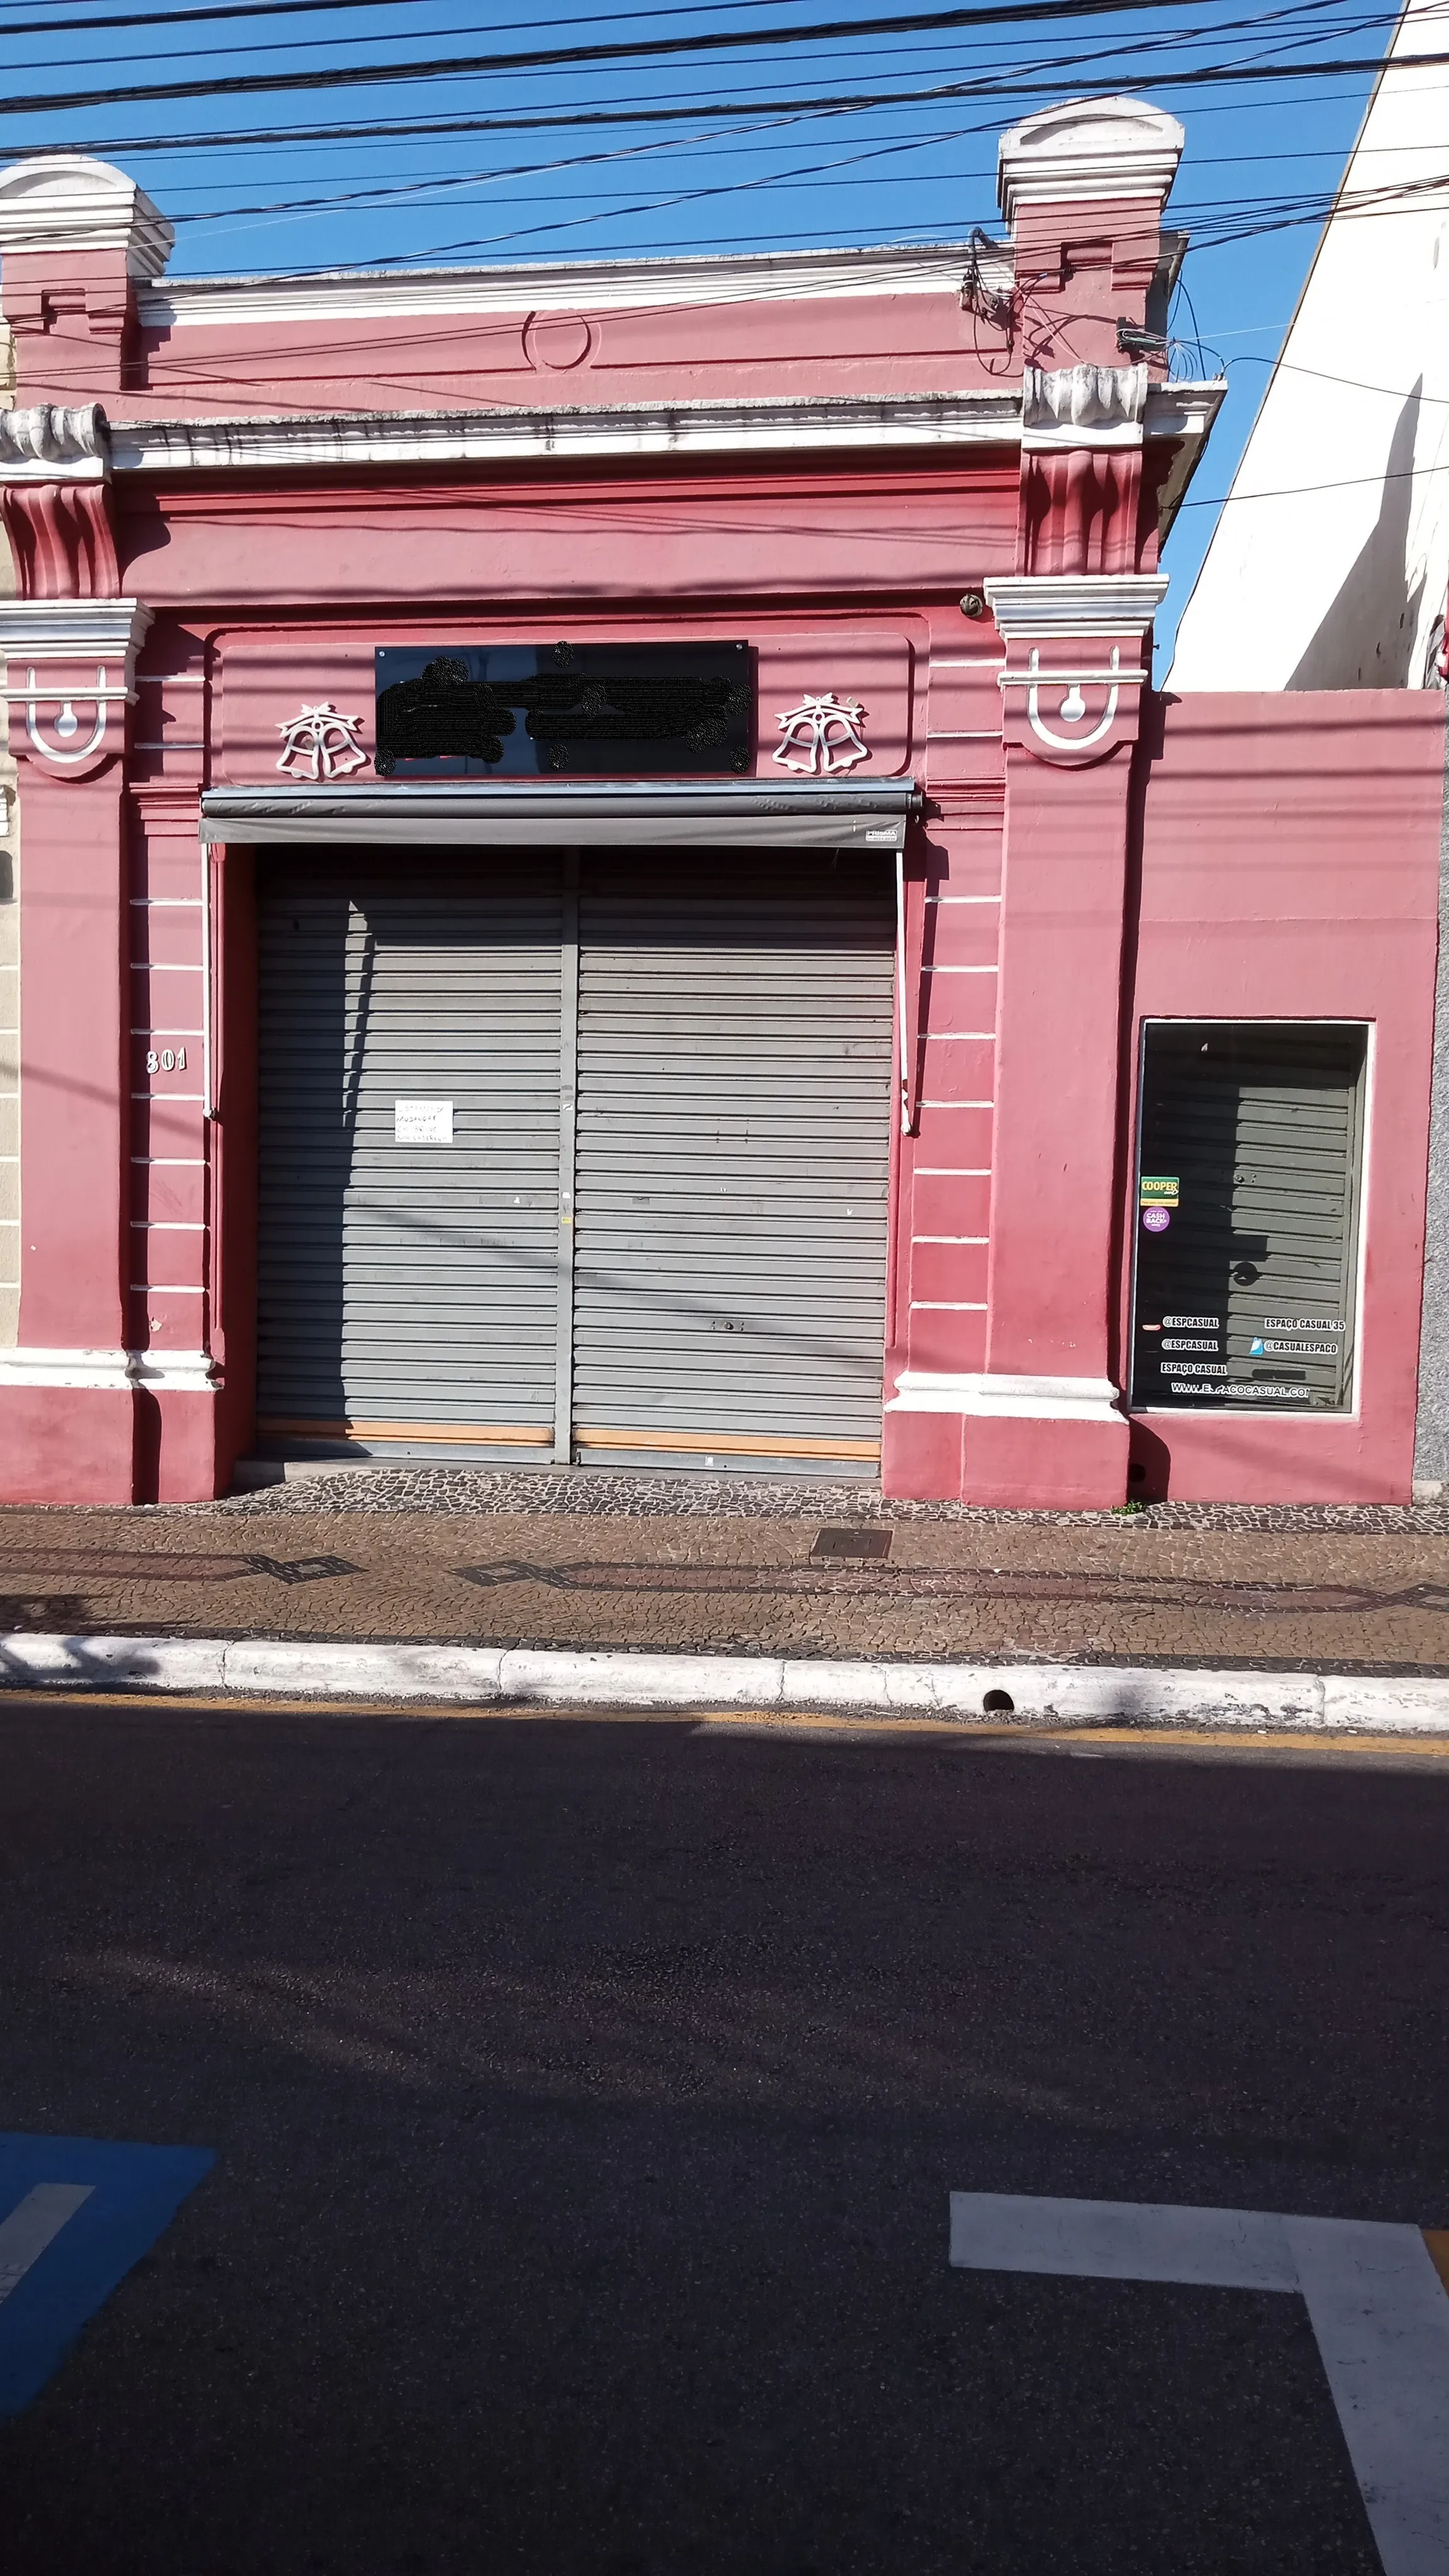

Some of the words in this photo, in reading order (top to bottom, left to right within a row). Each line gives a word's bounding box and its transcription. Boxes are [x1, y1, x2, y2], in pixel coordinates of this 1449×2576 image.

[147, 1046, 187, 1074] 801
[1141, 1181, 1178, 1191] COOPER
[1163, 1316, 1219, 1328] @ESPCASUAL
[1265, 1318, 1298, 1331] ESPAÇO
[1299, 1319, 1331, 1330] CASUAL
[1333, 1321, 1345, 1330] 35
[1162, 1339, 1218, 1351] @ESPCASUAL
[1264, 1341, 1337, 1354] @CASUALESPACO
[1161, 1362, 1193, 1375] ESPAÇO
[1194, 1363, 1227, 1375] CASUAL
